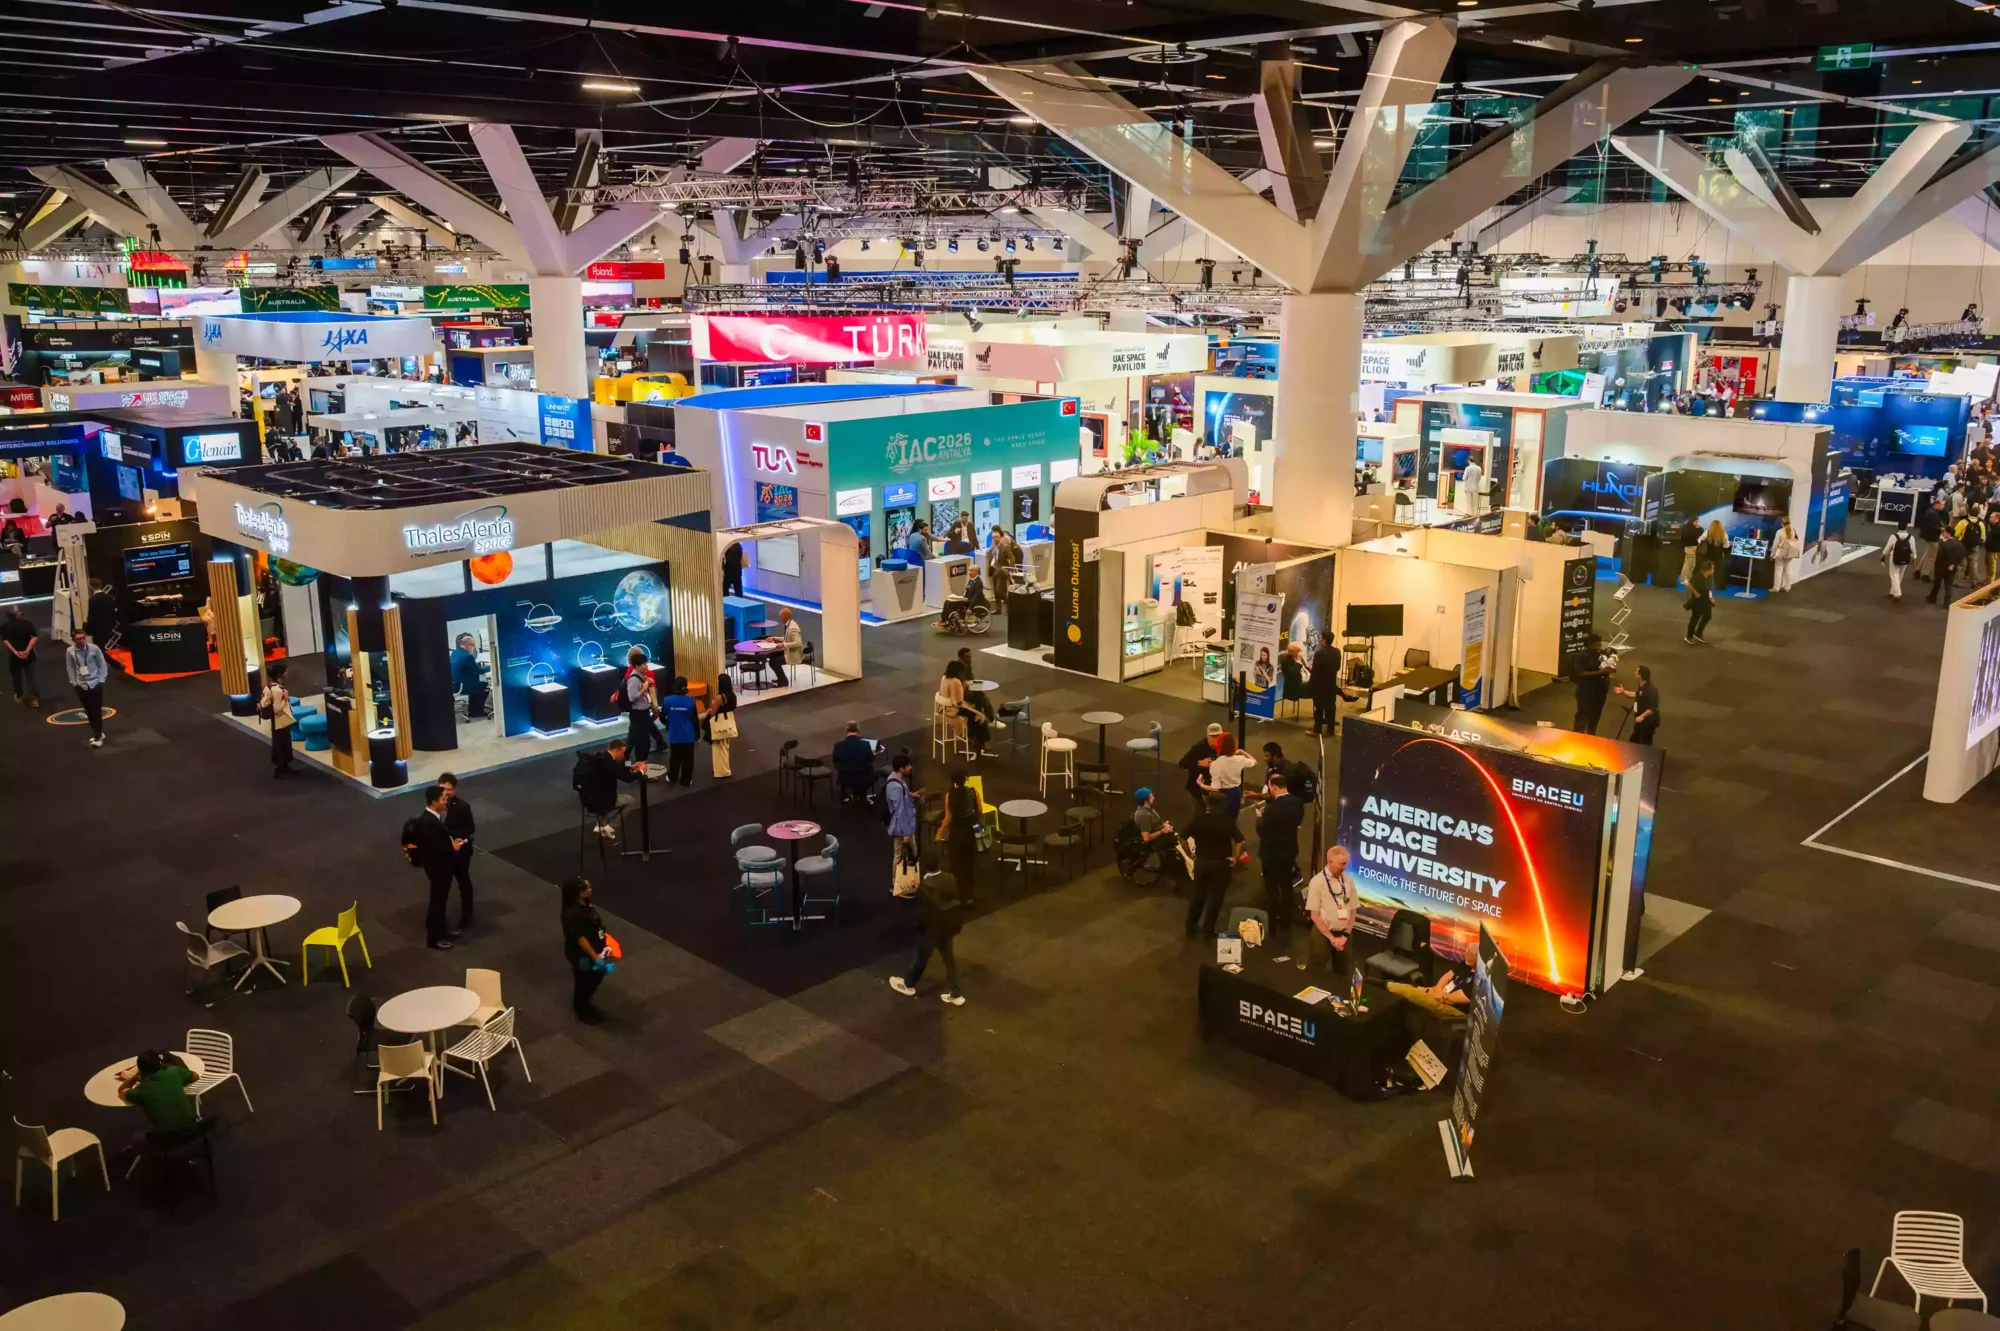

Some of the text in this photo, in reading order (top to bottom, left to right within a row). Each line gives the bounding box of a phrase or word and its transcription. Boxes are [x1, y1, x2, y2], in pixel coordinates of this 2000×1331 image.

[267, 298, 306, 306] AUSTRALIA
[204, 323, 222, 344] JAXA
[321, 327, 368, 353] JAXA
[928, 350, 963, 361] UAE SPACE
[1112, 352, 1146, 363] UAE SPACE
[1362, 356, 1390, 365] SPACE
[1509, 352, 1525, 362] SPACE
[928, 360, 964, 371] PAVILION
[1112, 362, 1146, 372] PAVILION
[1362, 366, 1390, 375] ILION
[1498, 361, 1525, 373] PAVILION
[11, 393, 35, 402] MITRE
[159, 390, 190, 401] SPACE
[186, 438, 236, 460] Glenair
[937, 432, 972, 450] 2026
[752, 445, 794, 473] TUA
[898, 437, 937, 465] IAC
[937, 447, 972, 461] ANTALYA
[476, 536, 512, 552] Space
[1071, 543, 1080, 619] Lunar Outpost
[1512, 778, 1584, 806] SPACEU
[1544, 800, 1563, 808] CENTRAL
[1362, 795, 1494, 846] AMERICA'S
[1360, 818, 1437, 856] SPACE
[1360, 841, 1506, 898] UNIVERSITY
[1358, 866, 1502, 918] FORGING THE FUTURE OF SPACE
[1239, 999, 1316, 1039] SPACEU
[1240, 1017, 1266, 1029] UNIVERSITY
[1273, 1029, 1294, 1040] CENTRAL
